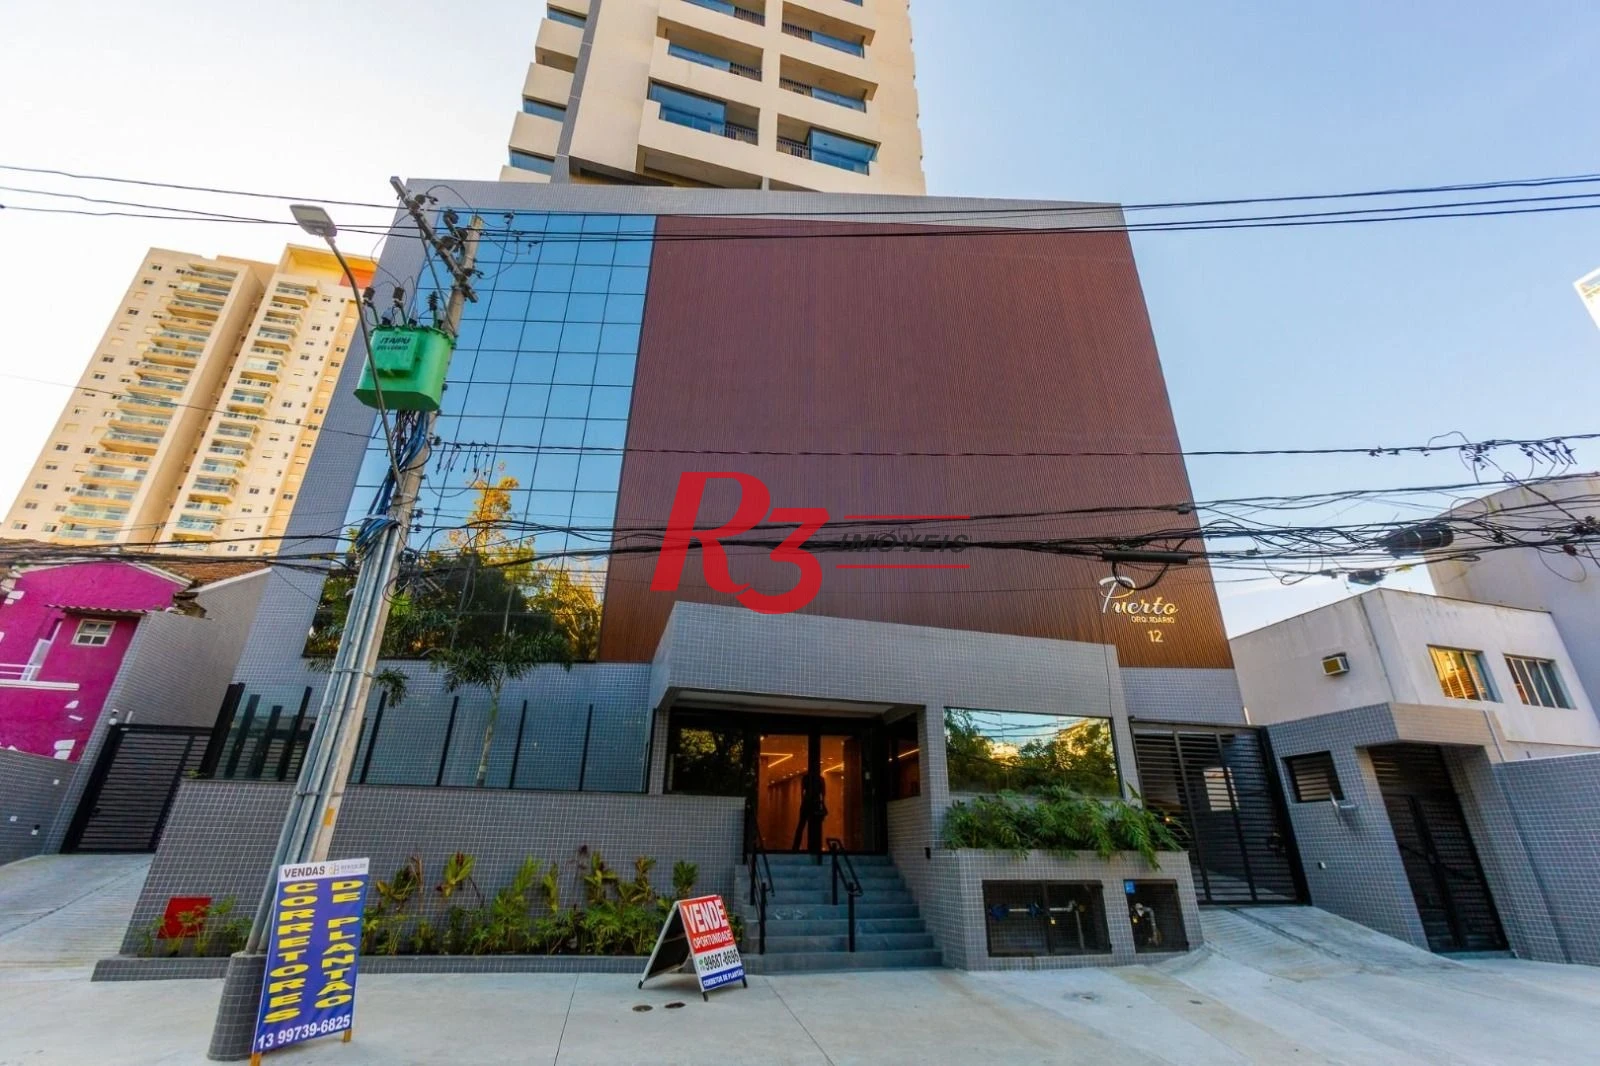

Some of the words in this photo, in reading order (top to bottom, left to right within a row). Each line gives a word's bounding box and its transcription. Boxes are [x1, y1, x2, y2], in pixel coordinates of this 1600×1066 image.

[1098, 576, 1178, 615] Puerto
[1147, 629, 1164, 643] 12
[283, 865, 326, 879] VENDAS
[331, 879, 365, 904] DE
[683, 900, 728, 933] VENDE
[263, 881, 319, 1024] CORRETORES
[692, 930, 733, 949] OPORTUNIDADE
[314, 916, 361, 1009] PLANTÃO
[258, 1031, 274, 1050] 13
[277, 1013, 352, 1044] 99739-6825
